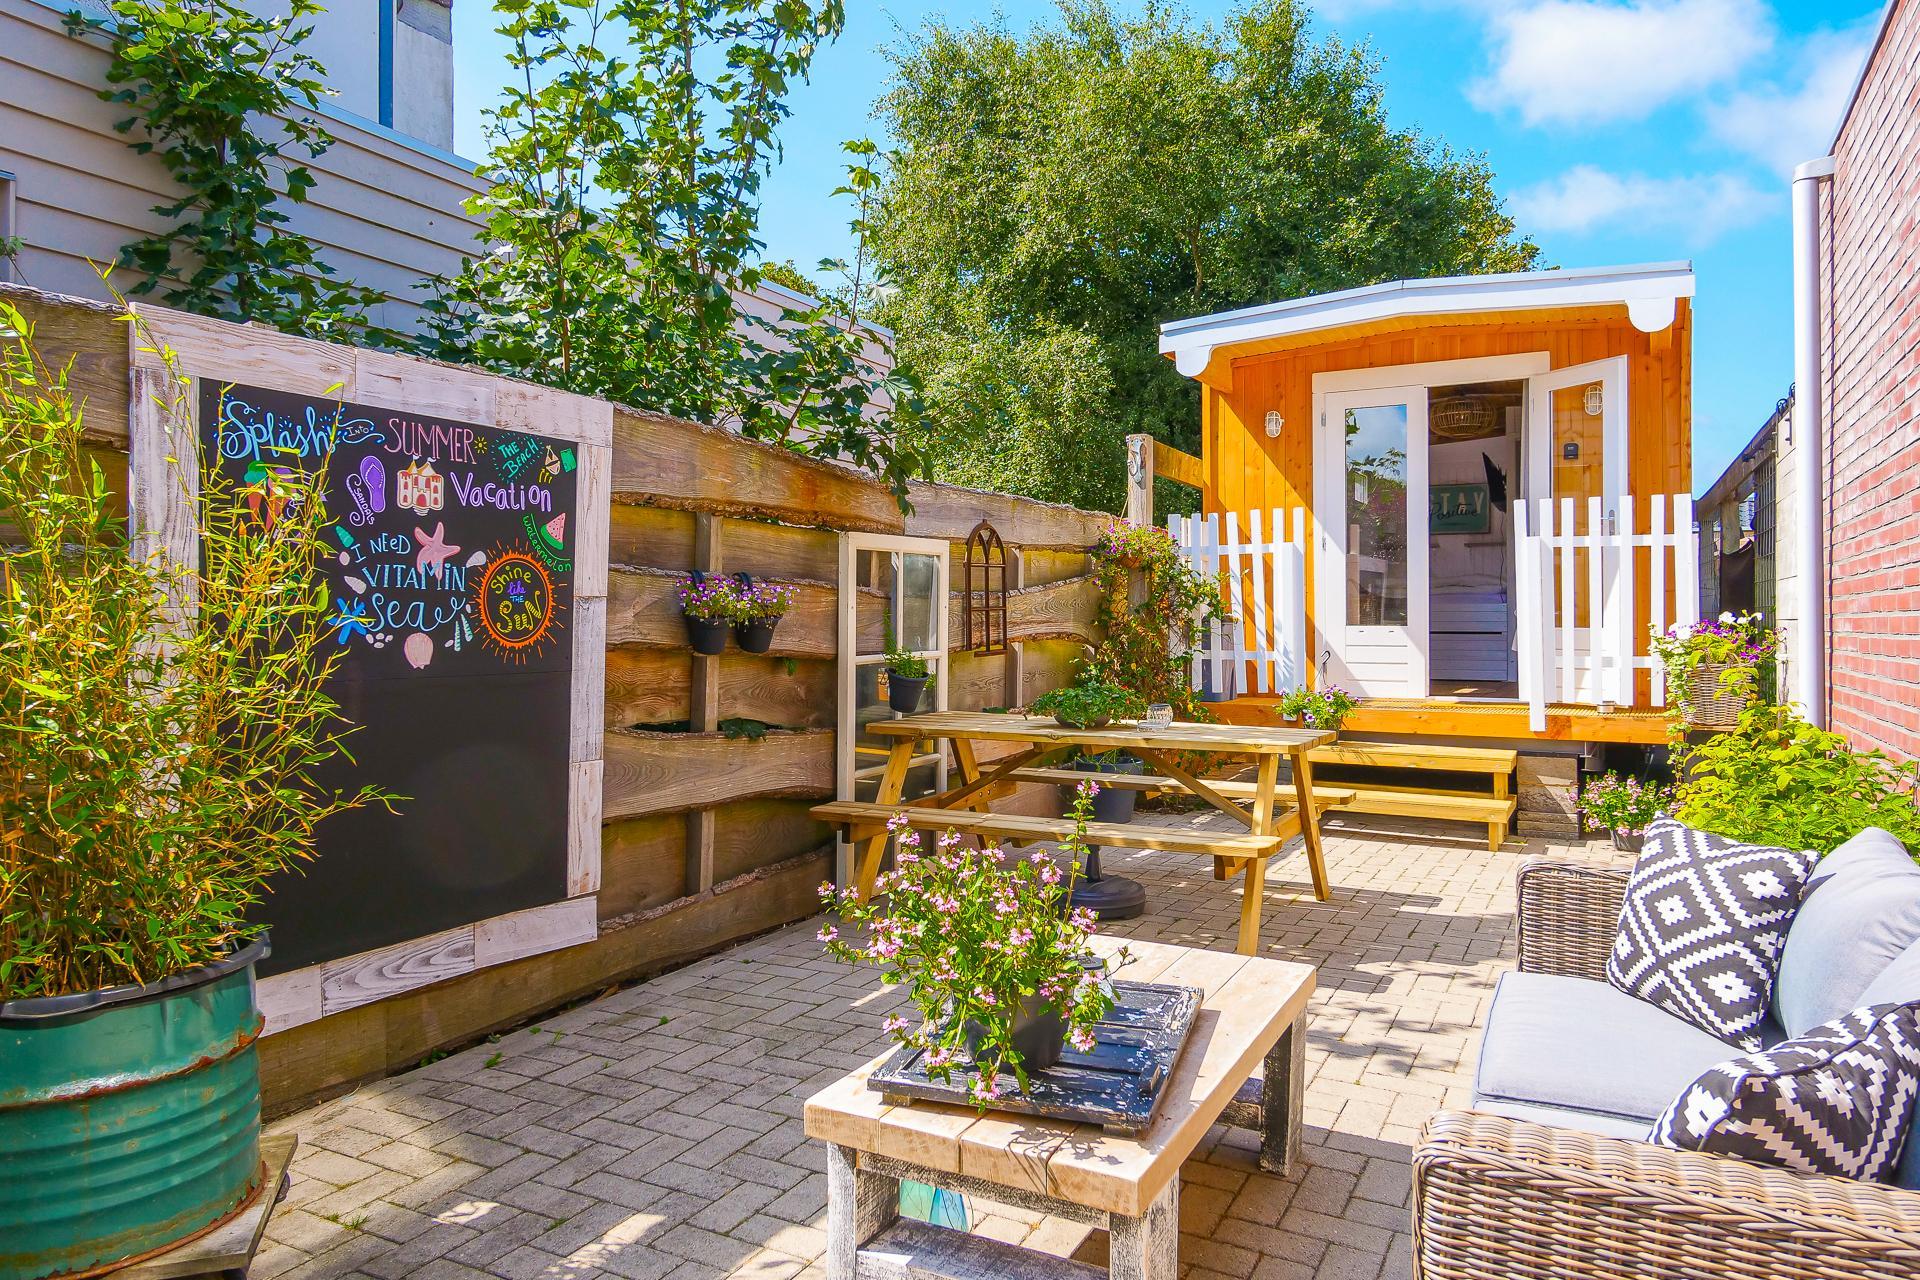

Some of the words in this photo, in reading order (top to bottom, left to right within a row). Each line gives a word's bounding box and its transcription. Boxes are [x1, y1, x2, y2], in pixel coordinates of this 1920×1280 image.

[218, 401, 336, 460] Splash
[384, 418, 477, 465] SUMMER
[498, 441, 520, 458] THE
[503, 436, 539, 478] BEACH
[450, 472, 551, 512] Vacation
[350, 544, 366, 563] I
[491, 566, 532, 594] Shine
[362, 593, 465, 632] Sea
[510, 595, 525, 603] THE
